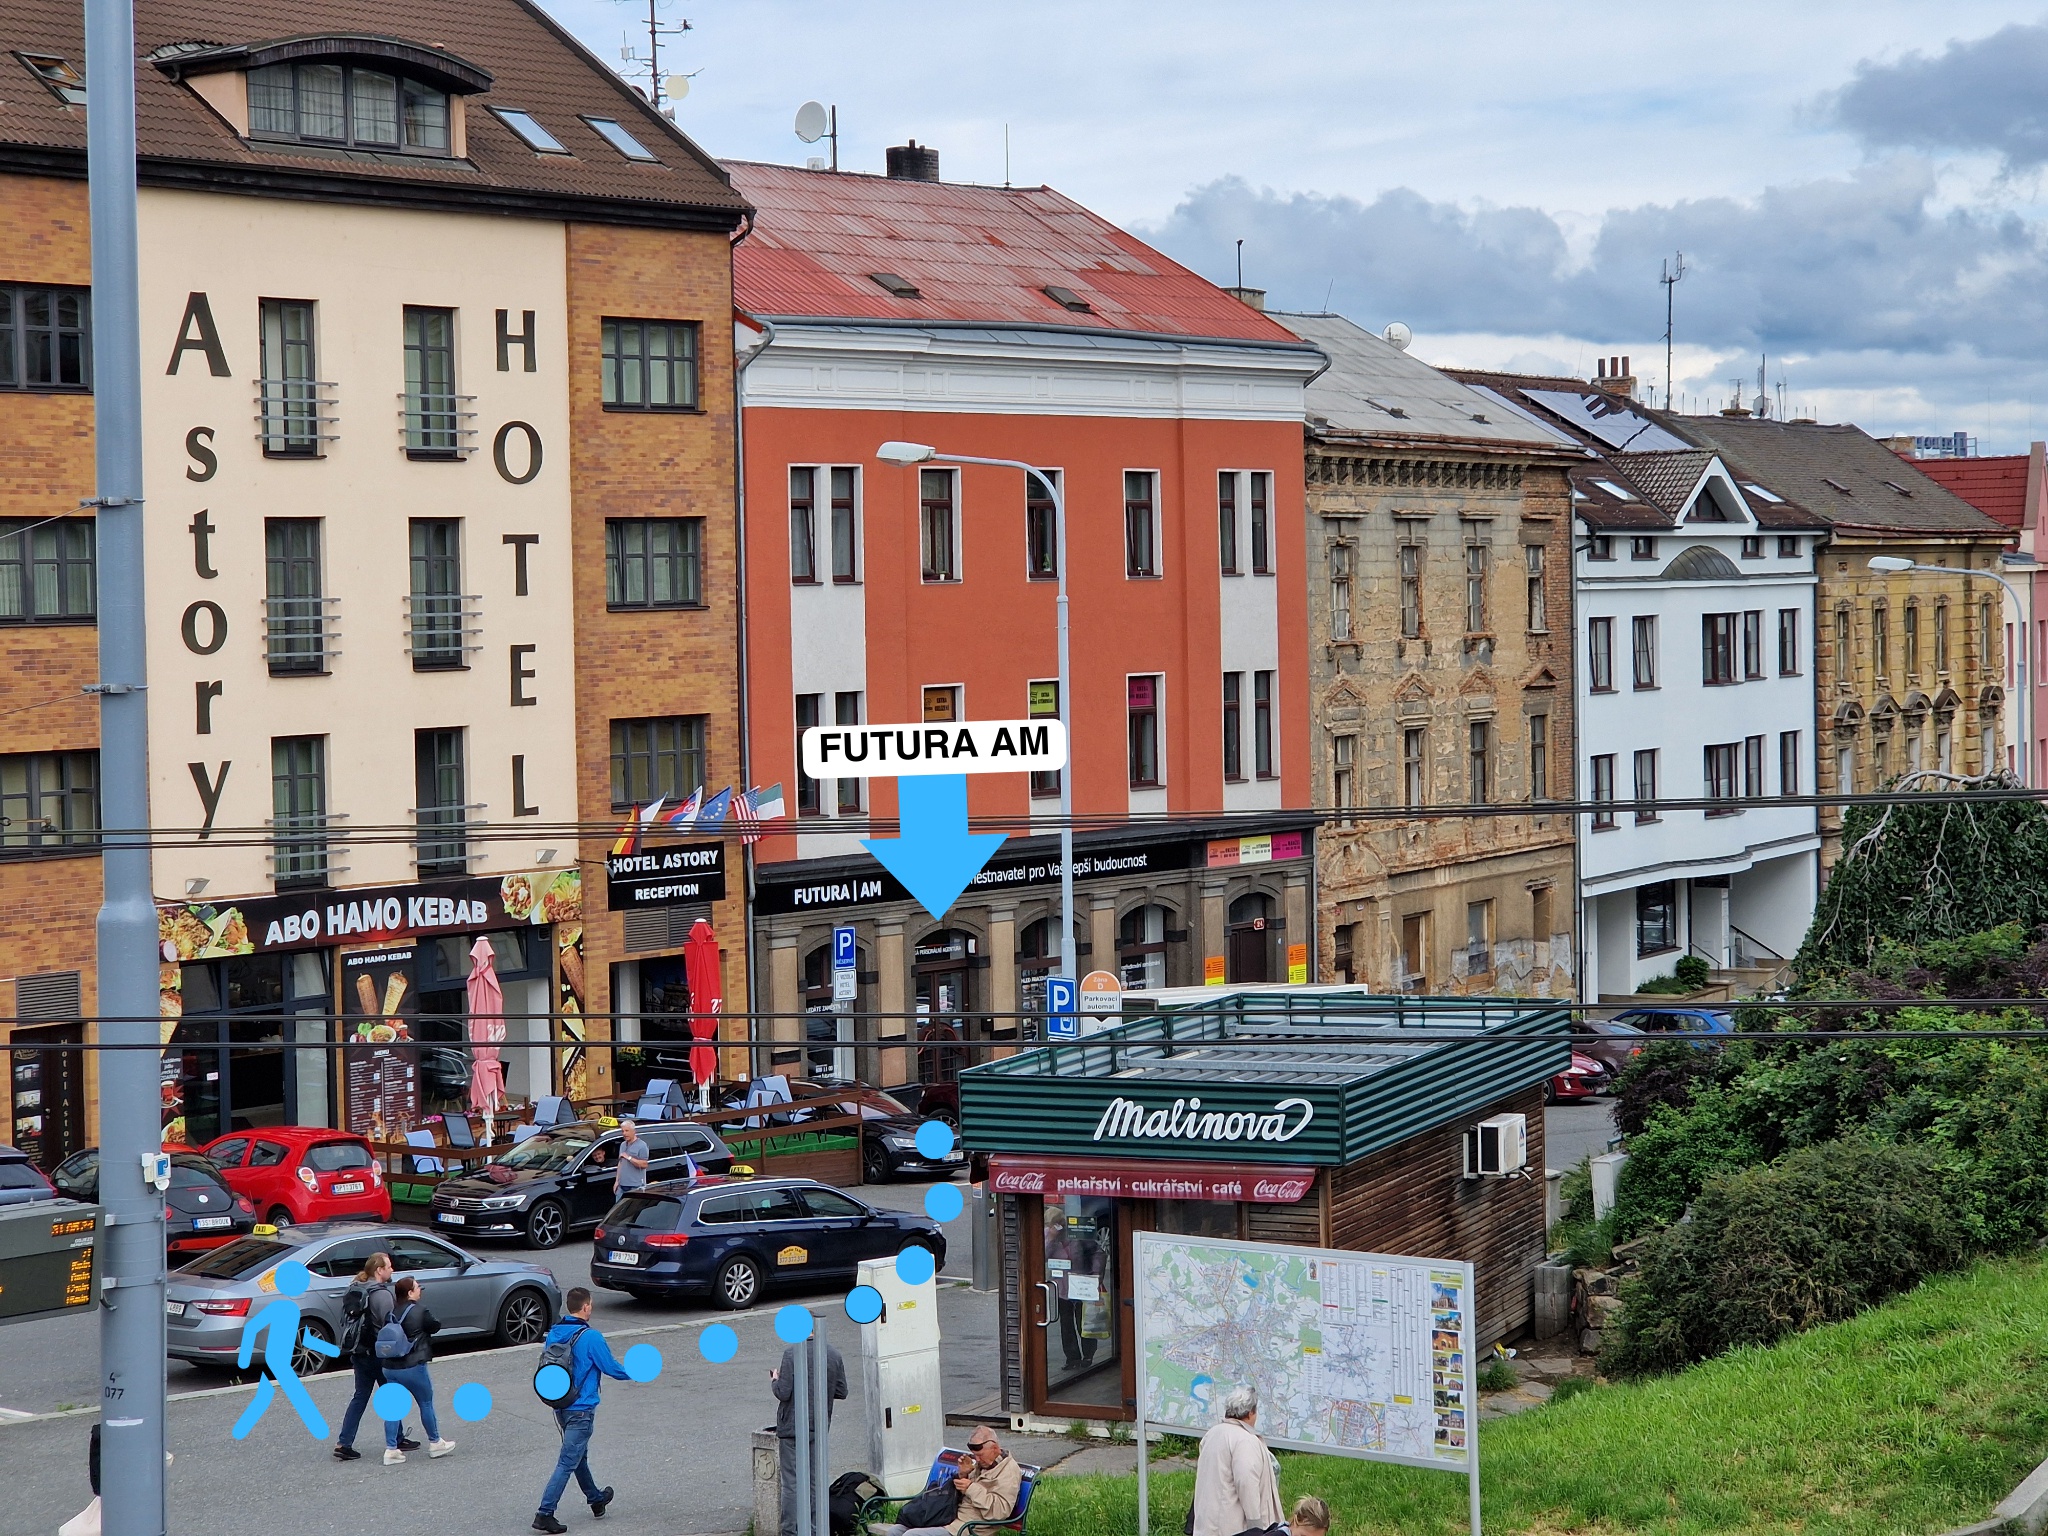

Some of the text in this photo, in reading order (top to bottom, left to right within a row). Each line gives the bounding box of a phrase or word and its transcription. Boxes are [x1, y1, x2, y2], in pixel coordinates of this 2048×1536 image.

[166, 292, 231, 839] Astory
[493, 309, 543, 817] HOTEL
[613, 850, 719, 874] HOTEL ASTORY
[1029, 867, 1046, 881] pro
[1072, 858, 1091, 876] epší
[1094, 853, 1148, 871] budoucnost
[635, 884, 699, 900] RECEPTION
[794, 880, 882, 905] FUTURA AM
[264, 897, 488, 945] ABO HAMO KEBAB
[839, 932, 852, 957] P
[347, 951, 412, 966] ABO HAMO KEBAB
[1053, 985, 1070, 1013] P
[1084, 995, 1118, 1003] Parkovací
[1057, 1176, 1121, 1191] pekařství
[1131, 1177, 1203, 1193] cukrářství
[1211, 1180, 1242, 1195] café
[255, 1225, 266, 1233] TAXI
[105, 1386, 124, 1400] 077
